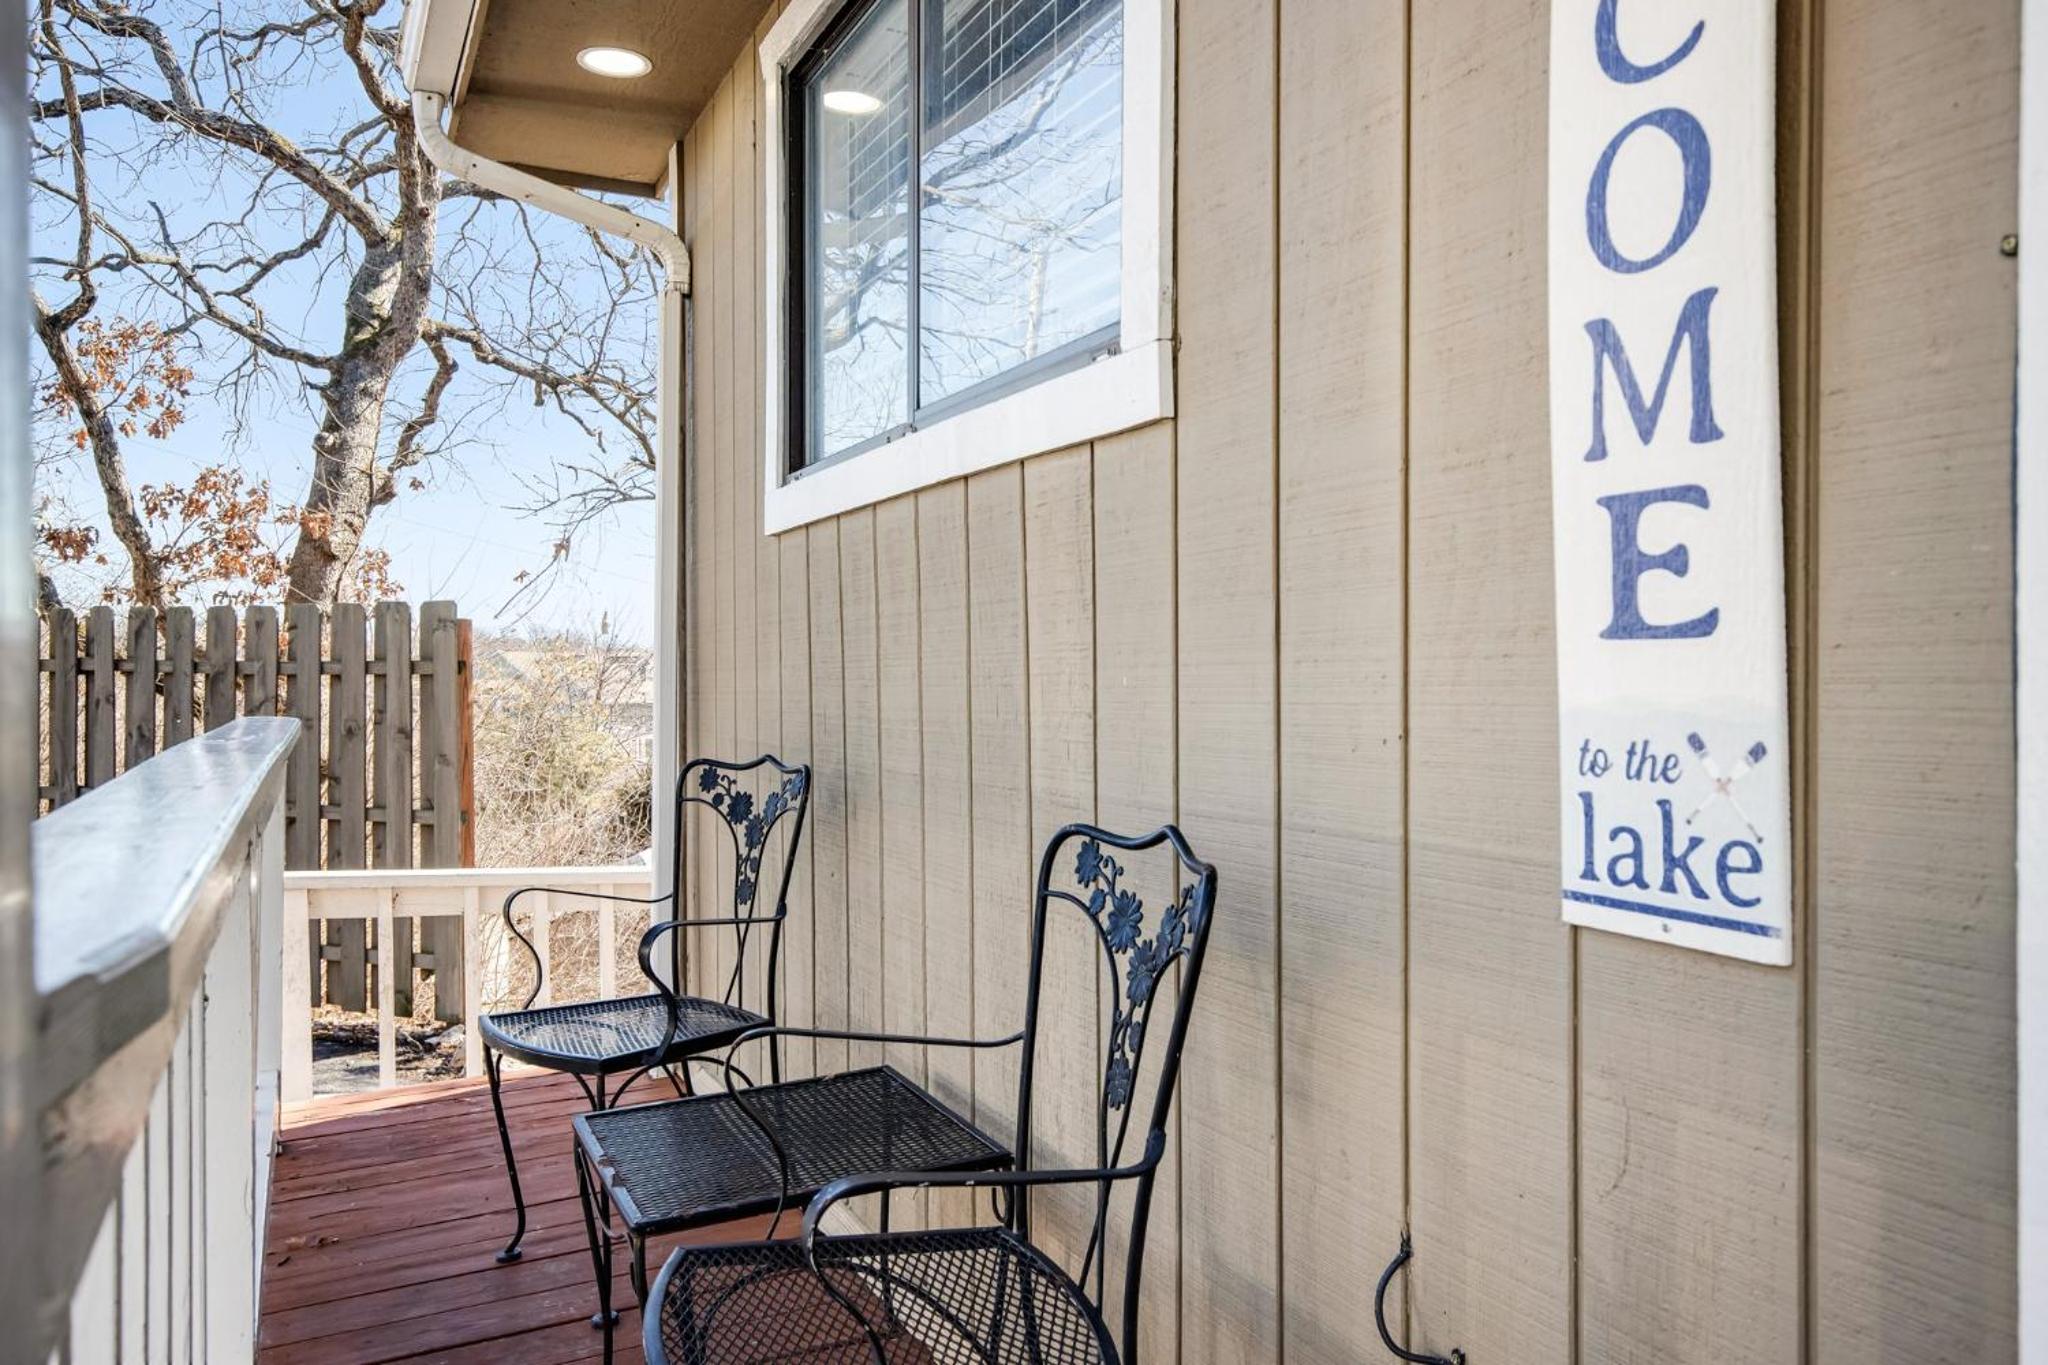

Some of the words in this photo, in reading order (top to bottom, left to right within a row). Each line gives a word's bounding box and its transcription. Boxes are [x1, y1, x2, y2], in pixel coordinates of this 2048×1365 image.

[1577, 738, 1614, 778] to
[1625, 739, 1683, 784] the
[1577, 790, 1764, 909] lake
